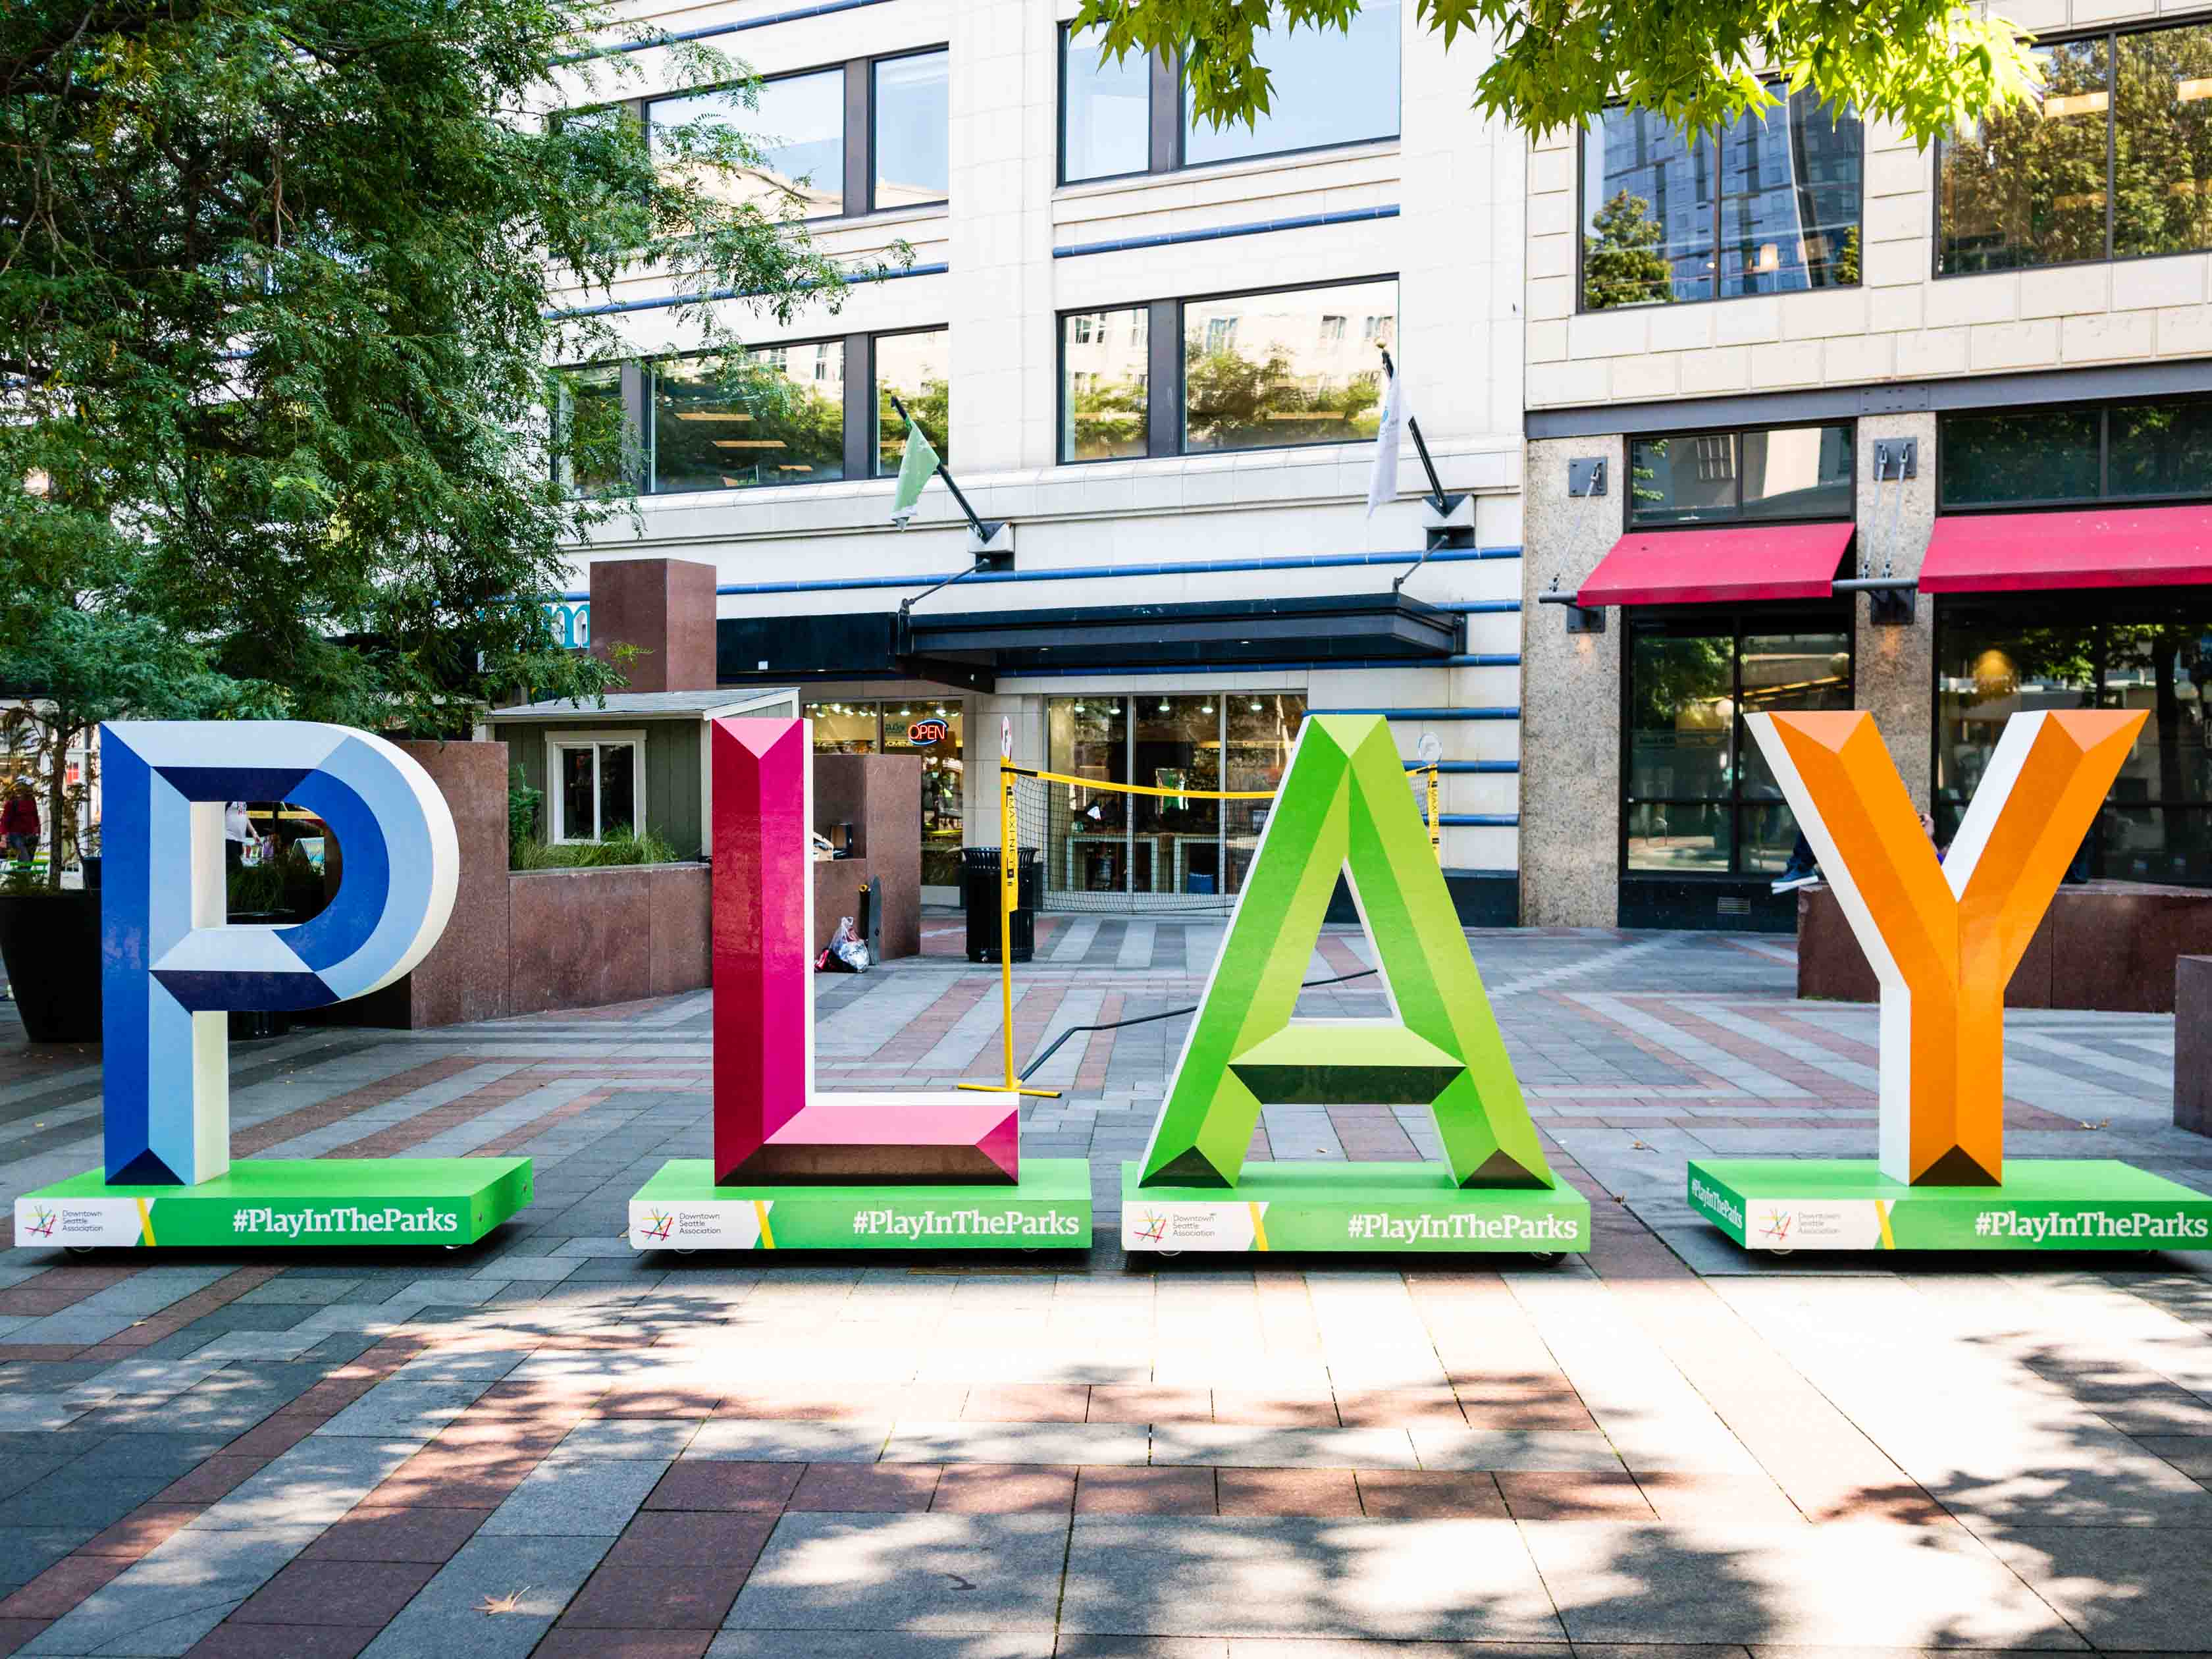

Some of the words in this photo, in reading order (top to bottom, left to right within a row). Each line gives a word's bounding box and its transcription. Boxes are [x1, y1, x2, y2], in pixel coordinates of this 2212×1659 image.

[908, 725, 945, 739] OPEN
[232, 1206, 458, 1238] #PlayInTheParks
[853, 1209, 1080, 1240] #PlayInTheParks
[1348, 1212, 1577, 1244] #PlayInTheParks
[1974, 1211, 2208, 1242] #PlayInTheParks
